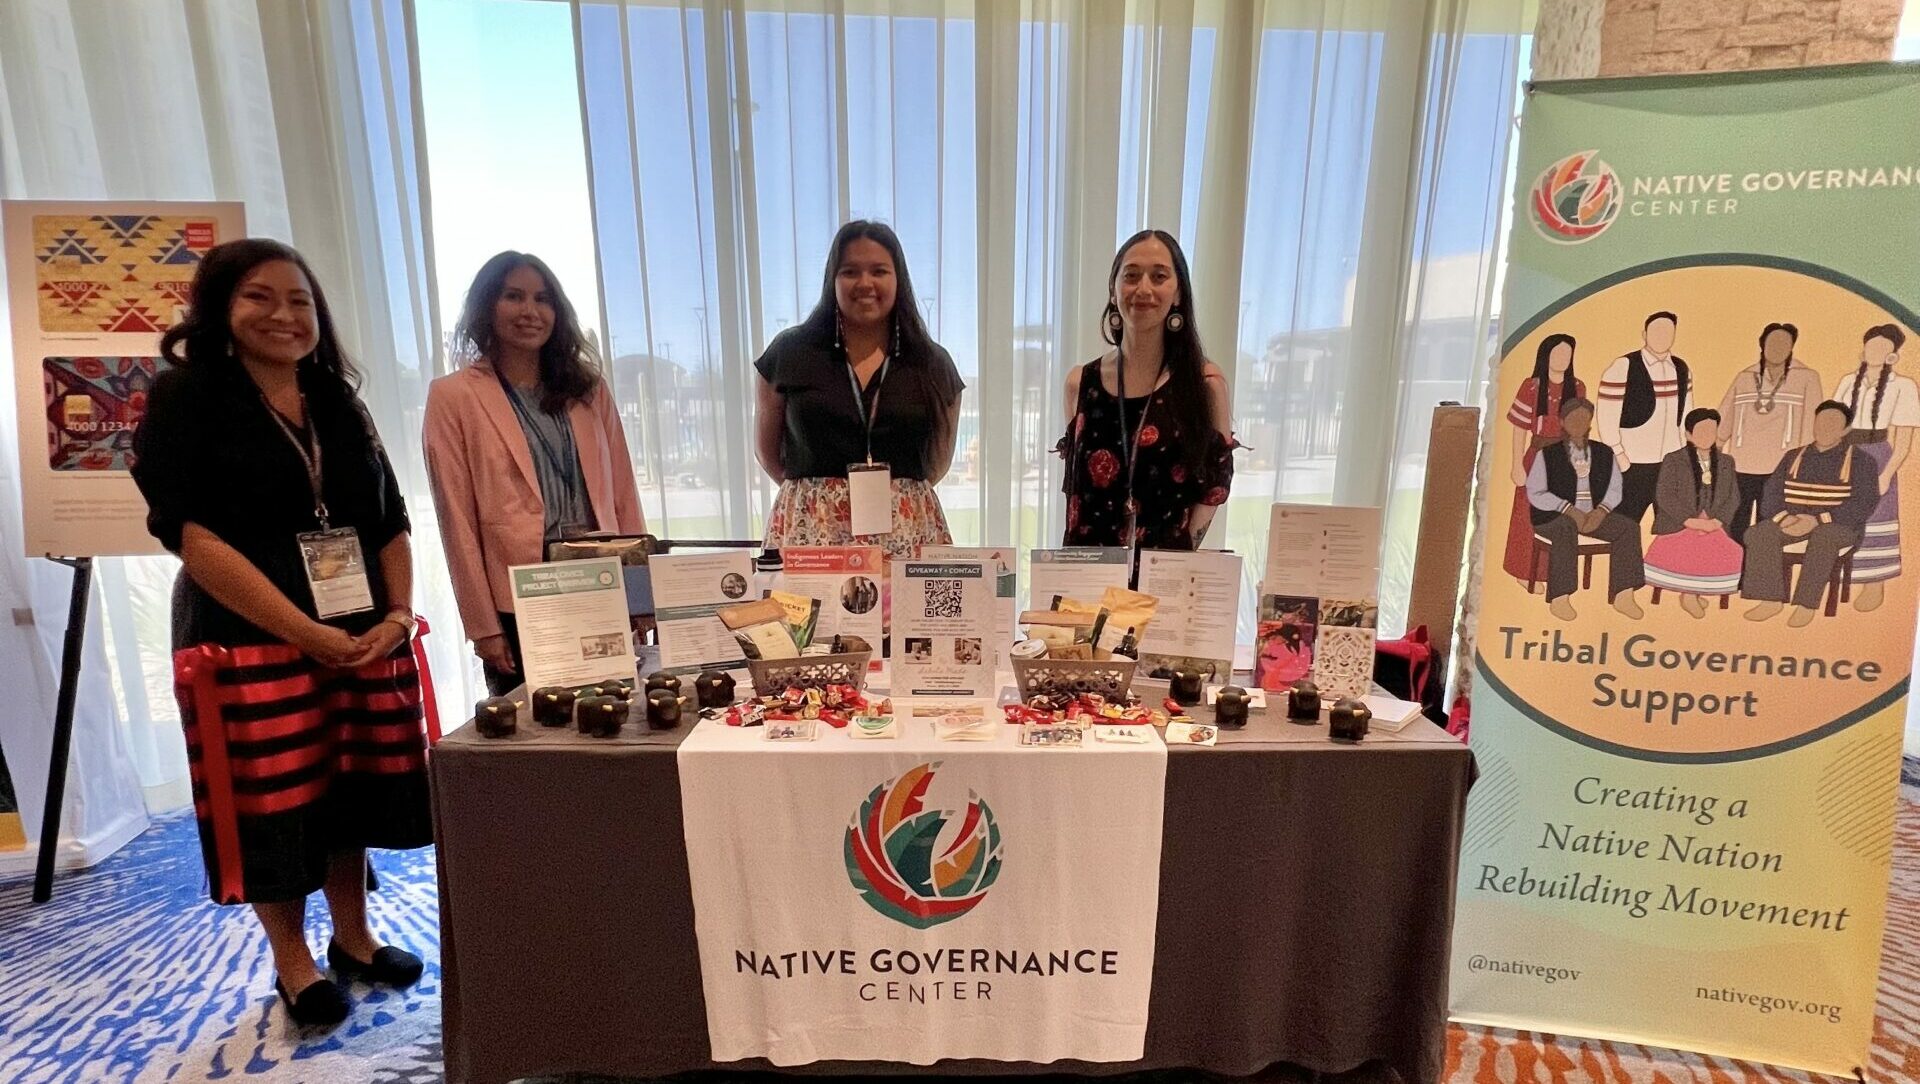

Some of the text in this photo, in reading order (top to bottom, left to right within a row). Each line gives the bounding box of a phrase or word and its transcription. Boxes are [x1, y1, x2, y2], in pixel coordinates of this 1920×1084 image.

[1633, 166, 1920, 196] NATIVE GOVERNAN
[1631, 199, 1738, 216] CENTER
[908, 566, 944, 575] GIVEAWAY
[949, 566, 981, 575] CONTACT
[1499, 626, 1882, 682] Tribal Governance
[1591, 673, 1759, 725] Support
[1573, 776, 1749, 825] Creating a
[1537, 822, 1784, 873] Native Nation
[1474, 864, 1851, 932] Rebuilding Movement
[735, 949, 1119, 979] NATIVE GOVERNANCE
[1467, 953, 1582, 984] @nativegov
[859, 981, 993, 1005] CENTER
[1695, 985, 1843, 1023] nativegov.org
